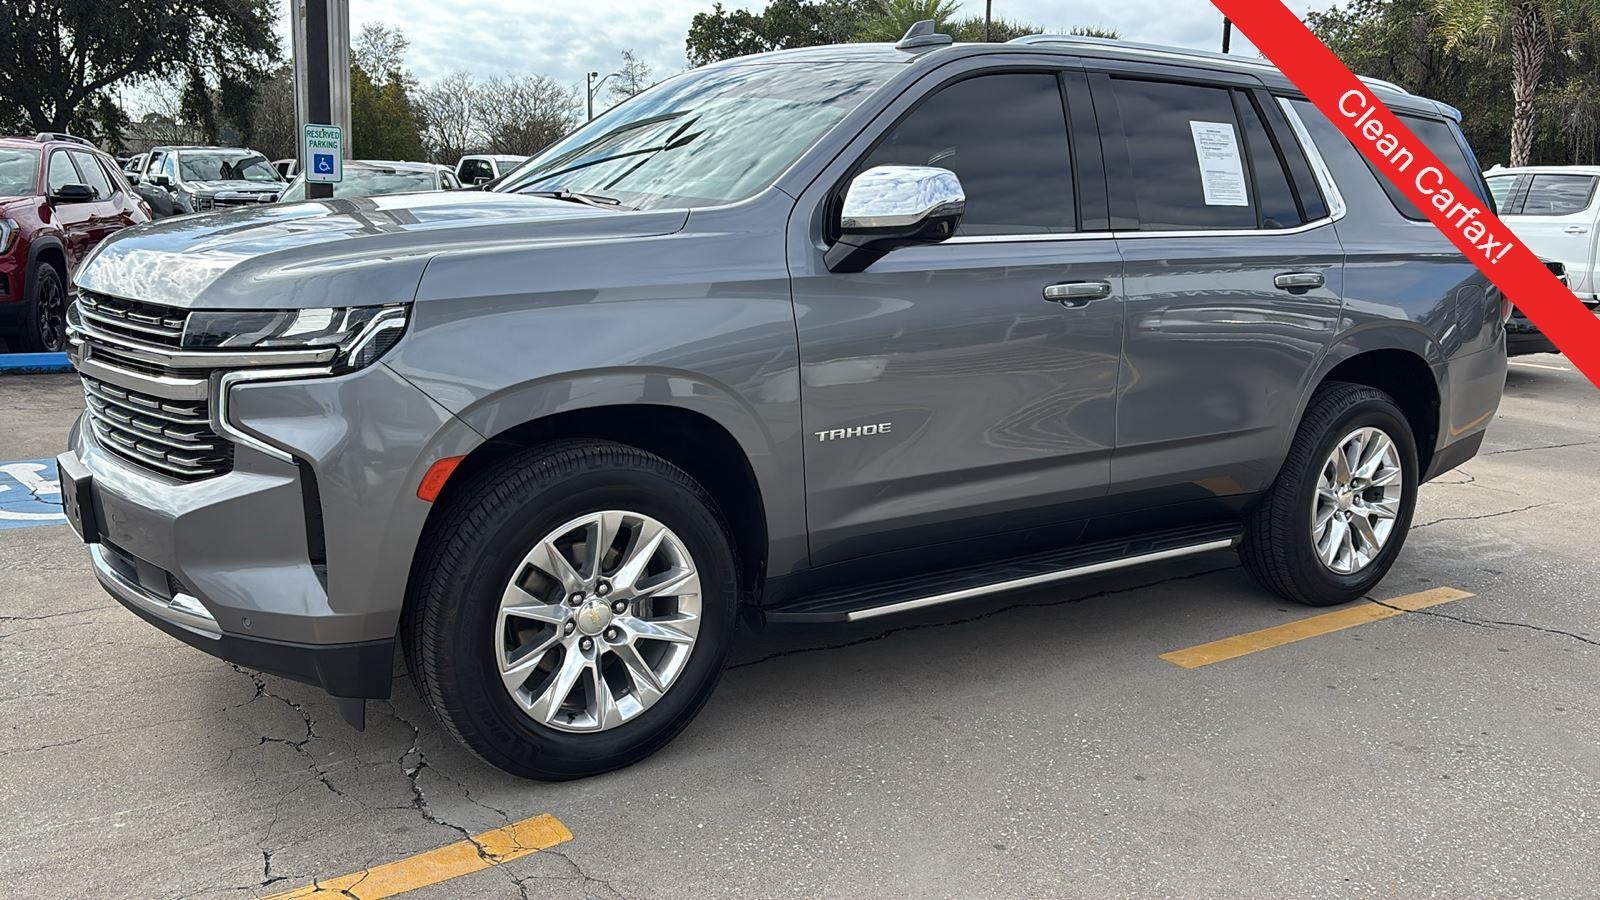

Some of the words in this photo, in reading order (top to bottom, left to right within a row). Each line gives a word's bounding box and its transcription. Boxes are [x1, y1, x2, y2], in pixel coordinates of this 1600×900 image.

[306, 130, 340, 139] RESERVED
[309, 140, 338, 149] PARKING
[814, 422, 892, 442] TAHOE
